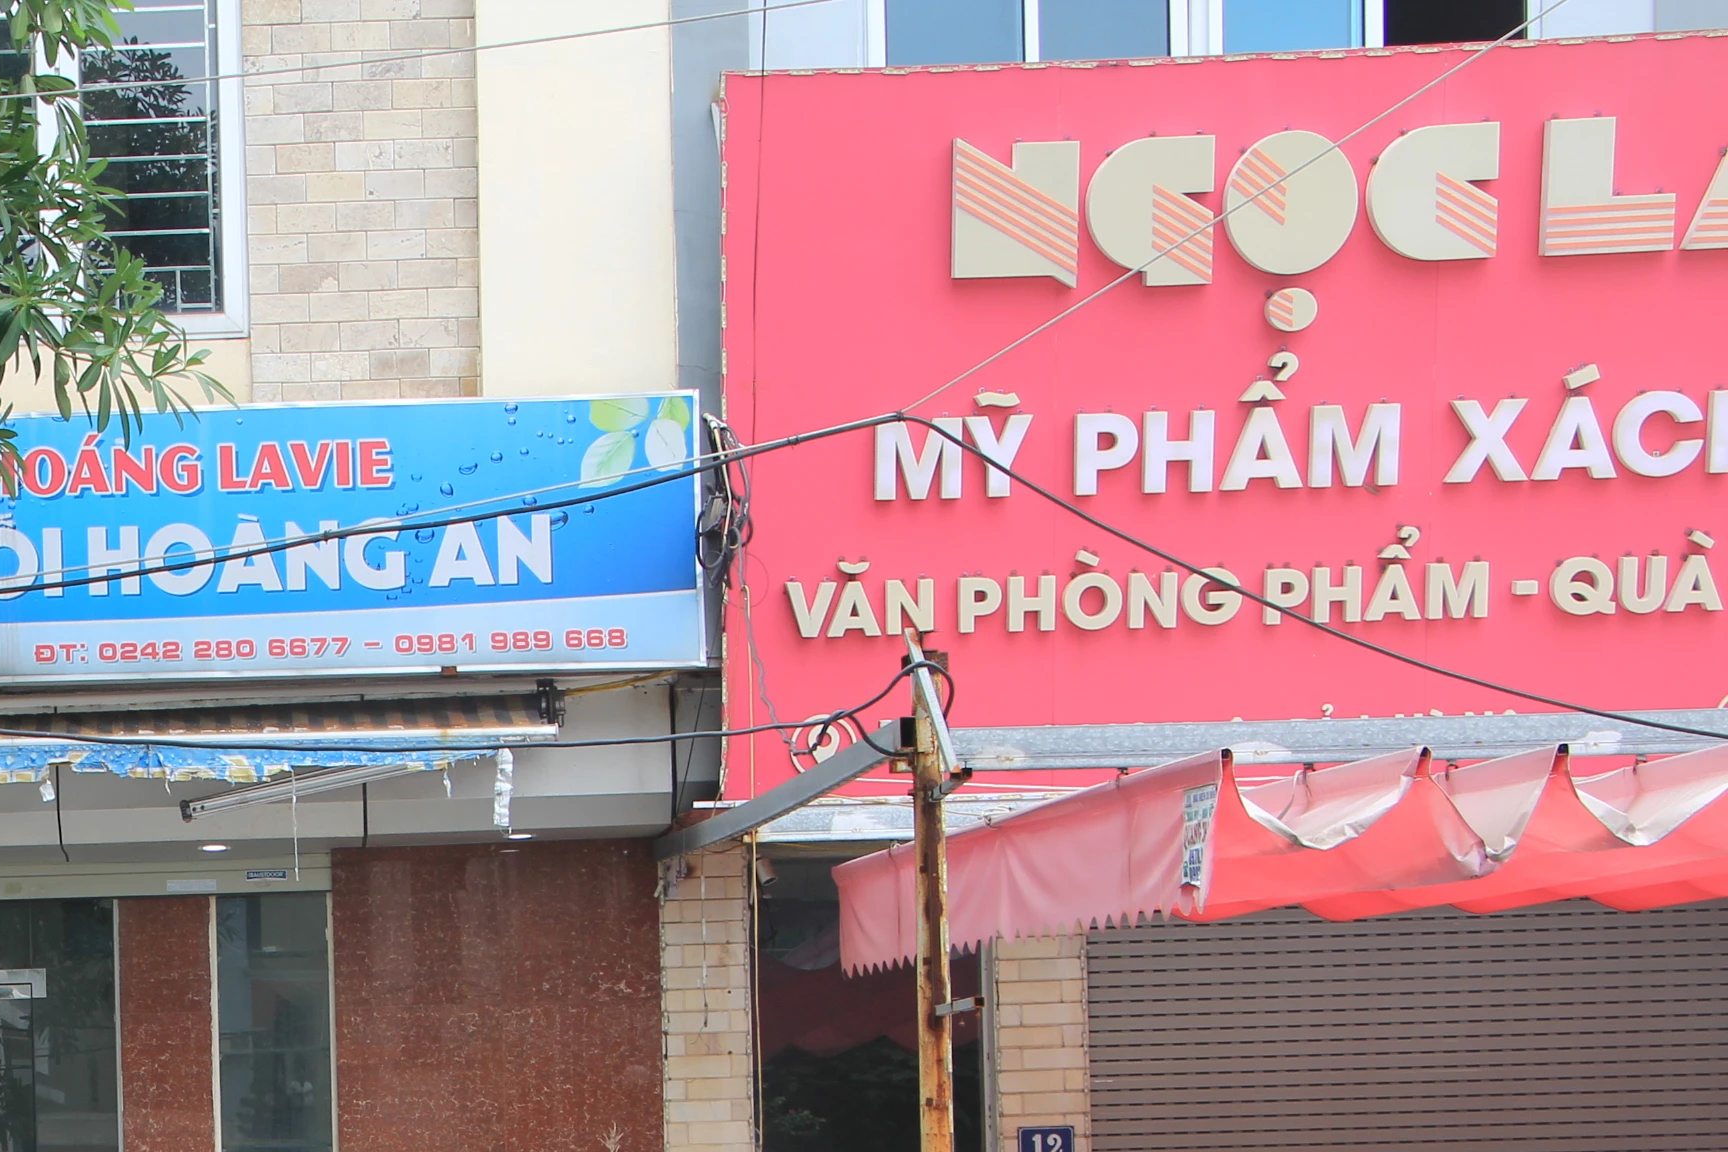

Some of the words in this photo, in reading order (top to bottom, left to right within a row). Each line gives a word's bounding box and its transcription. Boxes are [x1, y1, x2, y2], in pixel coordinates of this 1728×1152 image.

[951, 120, 1501, 333] NGỌC
[214, 437, 394, 494] LAVIE
[874, 389, 1034, 502] MỸ
[1074, 350, 1402, 497] PHẨM
[86, 512, 408, 597] HOÀNG
[427, 513, 553, 588] AN
[784, 558, 936, 639] VĂN
[957, 548, 1243, 635] PHÒNG
[1262, 525, 1490, 626] PHẨM
[1549, 530, 1725, 617] QUÀ
[34, 641, 88, 666] ĐT:
[98, 639, 183, 663] 0242
[192, 638, 257, 662] 280
[267, 636, 352, 660] 6677
[393, 632, 478, 657] 0981
[488, 629, 554, 654] 989
[563, 627, 629, 651] 668
